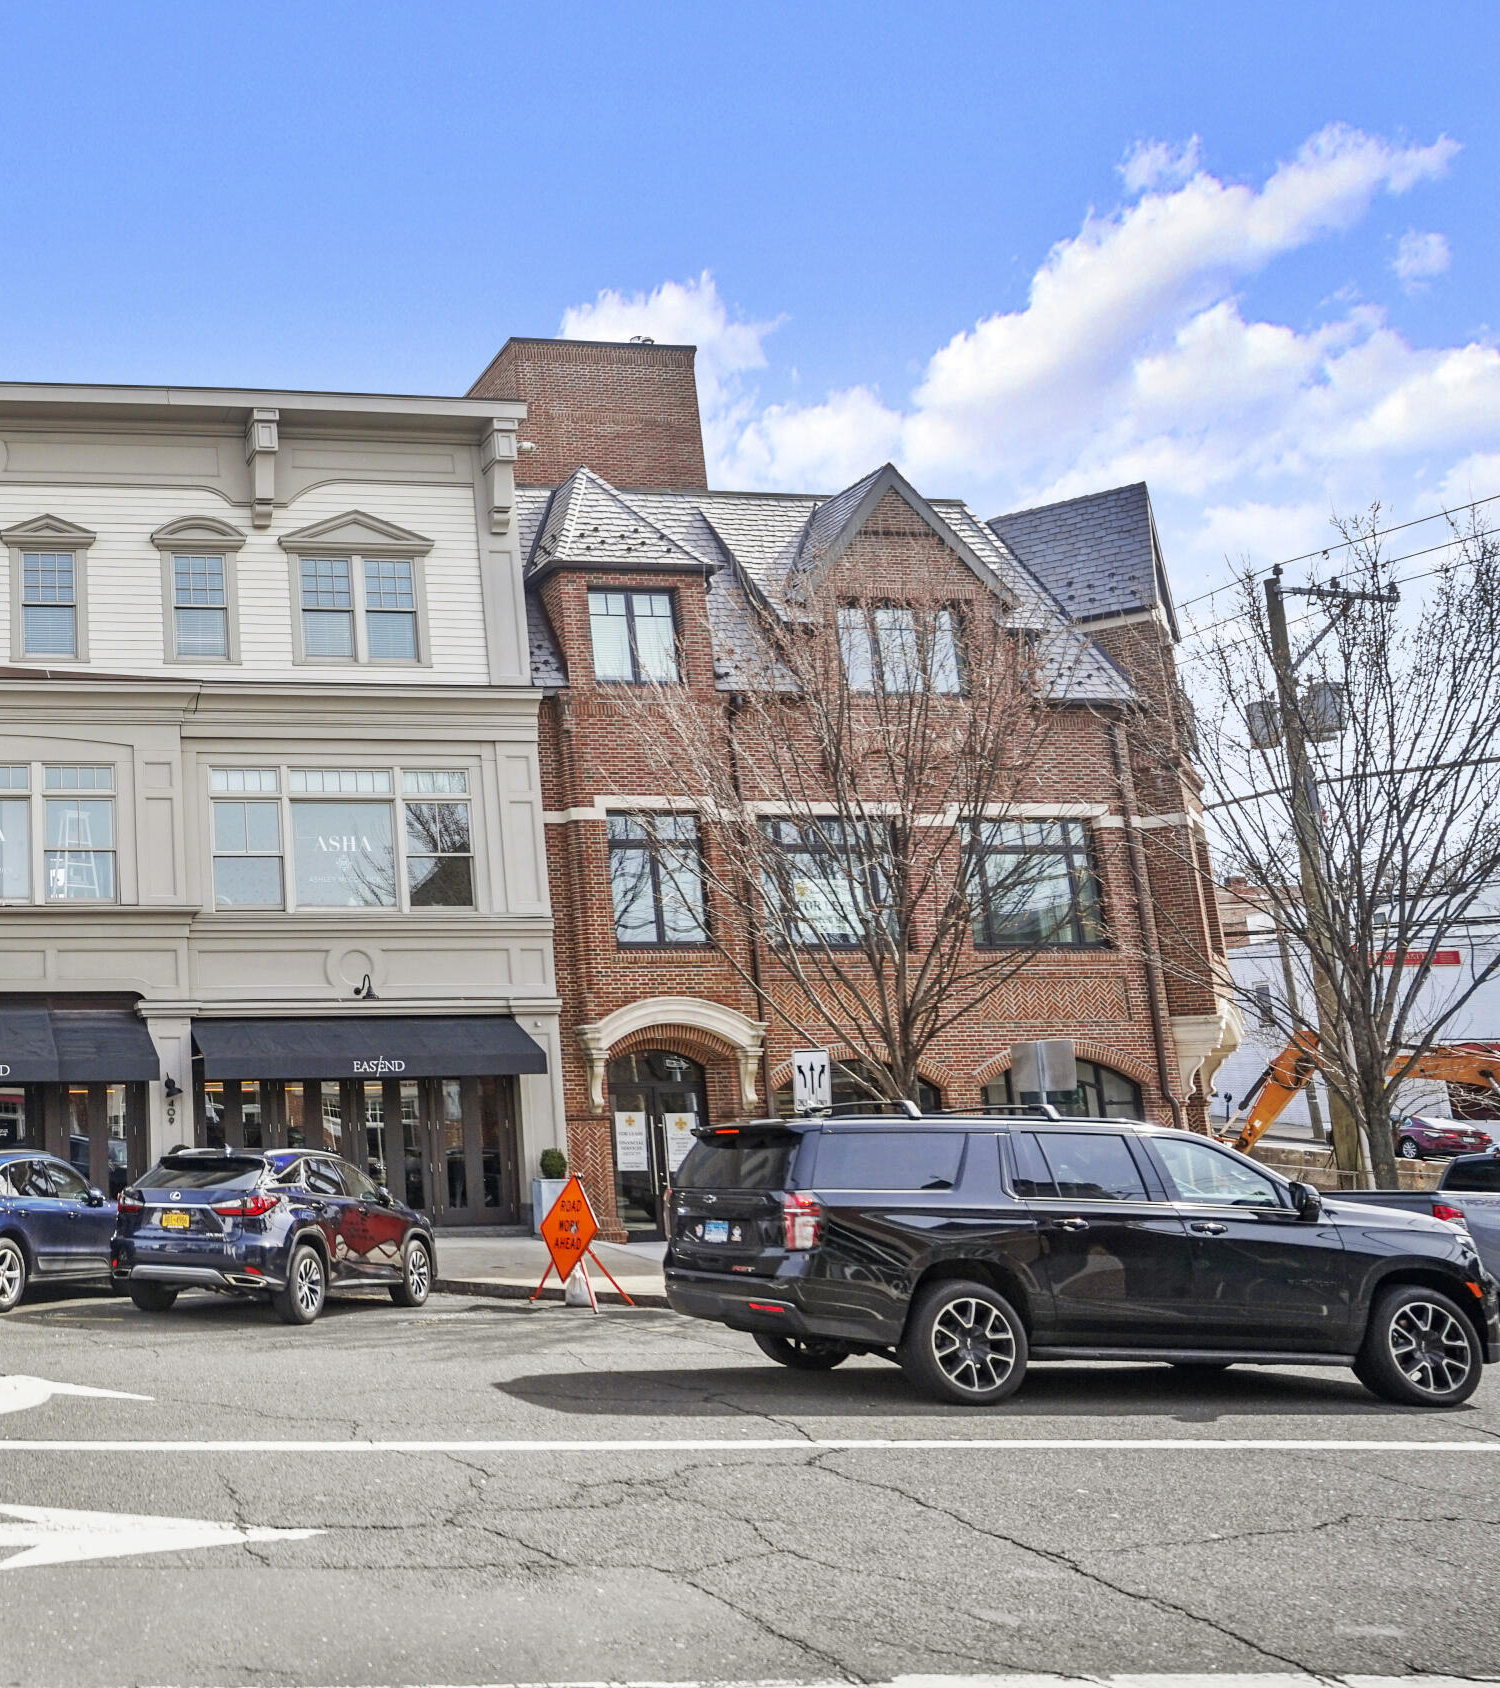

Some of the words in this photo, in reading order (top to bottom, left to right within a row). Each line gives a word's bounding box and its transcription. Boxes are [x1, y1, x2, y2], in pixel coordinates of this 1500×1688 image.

[315, 835, 372, 852] ASHA
[167, 1098, 176, 1125] 409
[560, 1200, 582, 1212] ROAD
[555, 1237, 582, 1250] AHEAD
